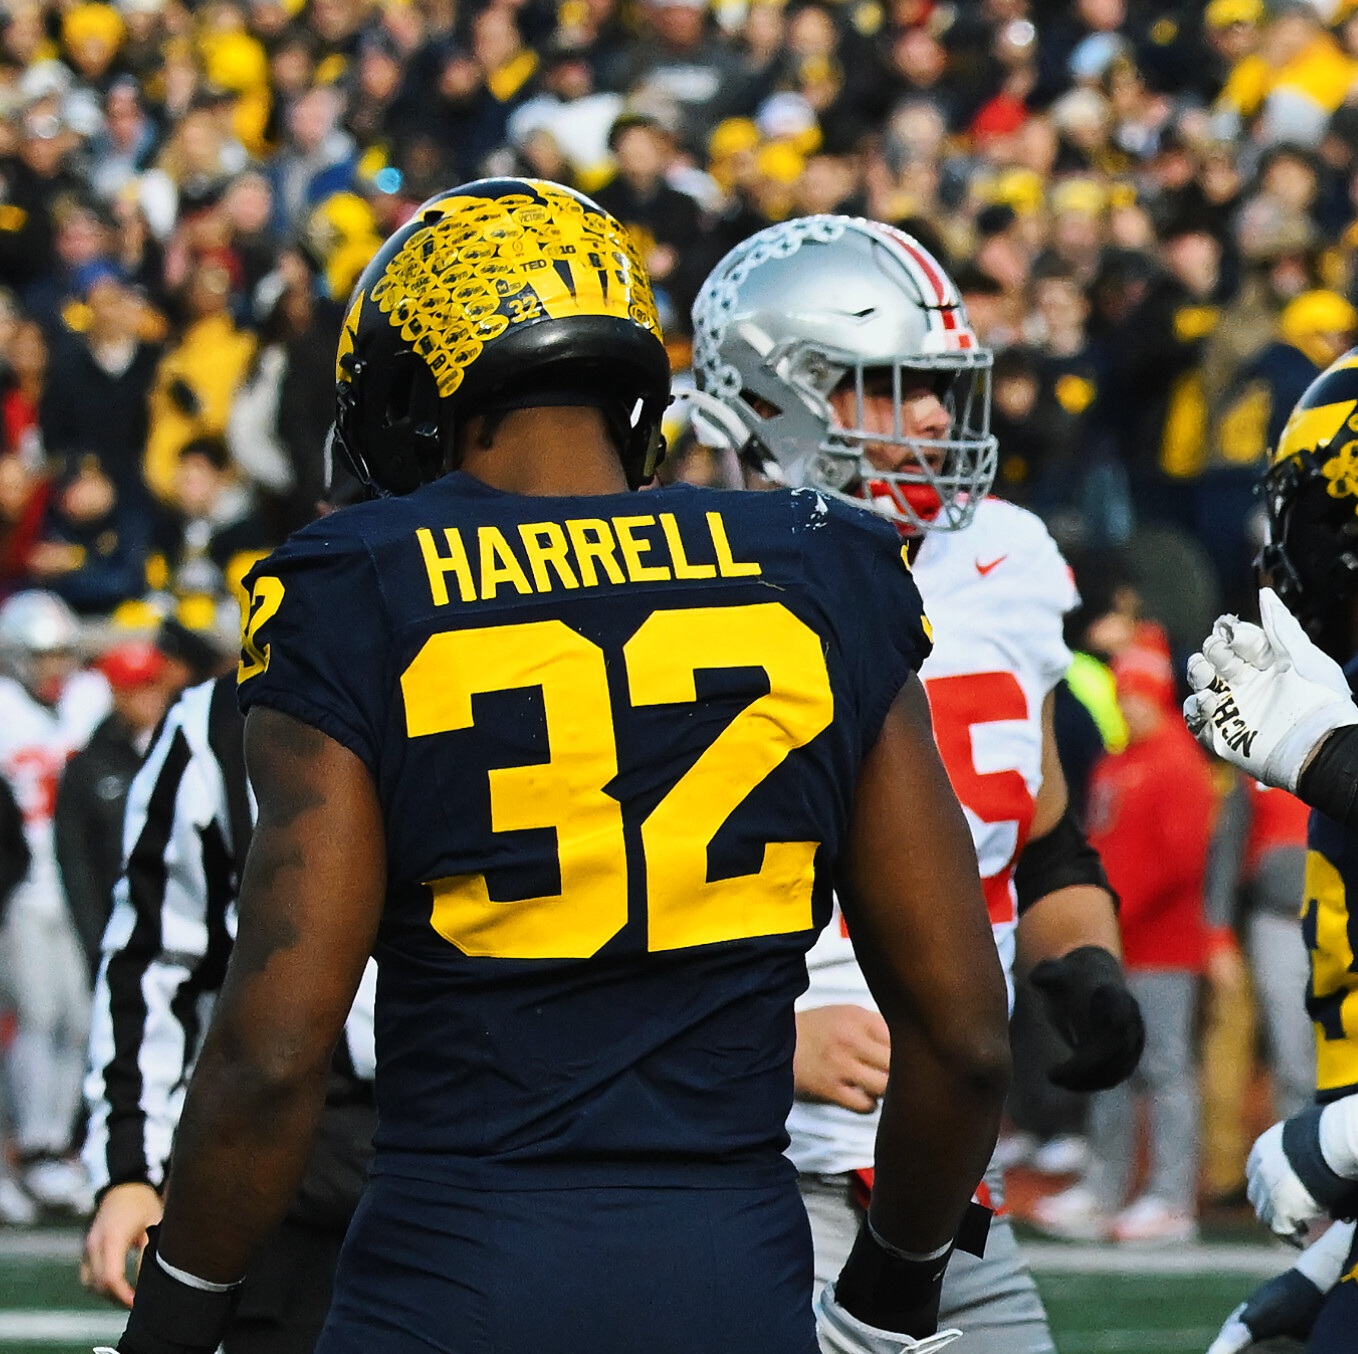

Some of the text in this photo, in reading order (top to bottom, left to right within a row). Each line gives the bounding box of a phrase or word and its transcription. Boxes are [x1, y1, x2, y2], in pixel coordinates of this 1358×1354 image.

[519, 259, 548, 272] TED
[508, 296, 542, 323] 32
[416, 511, 762, 607] HARRELL
[400, 602, 835, 959] 32
